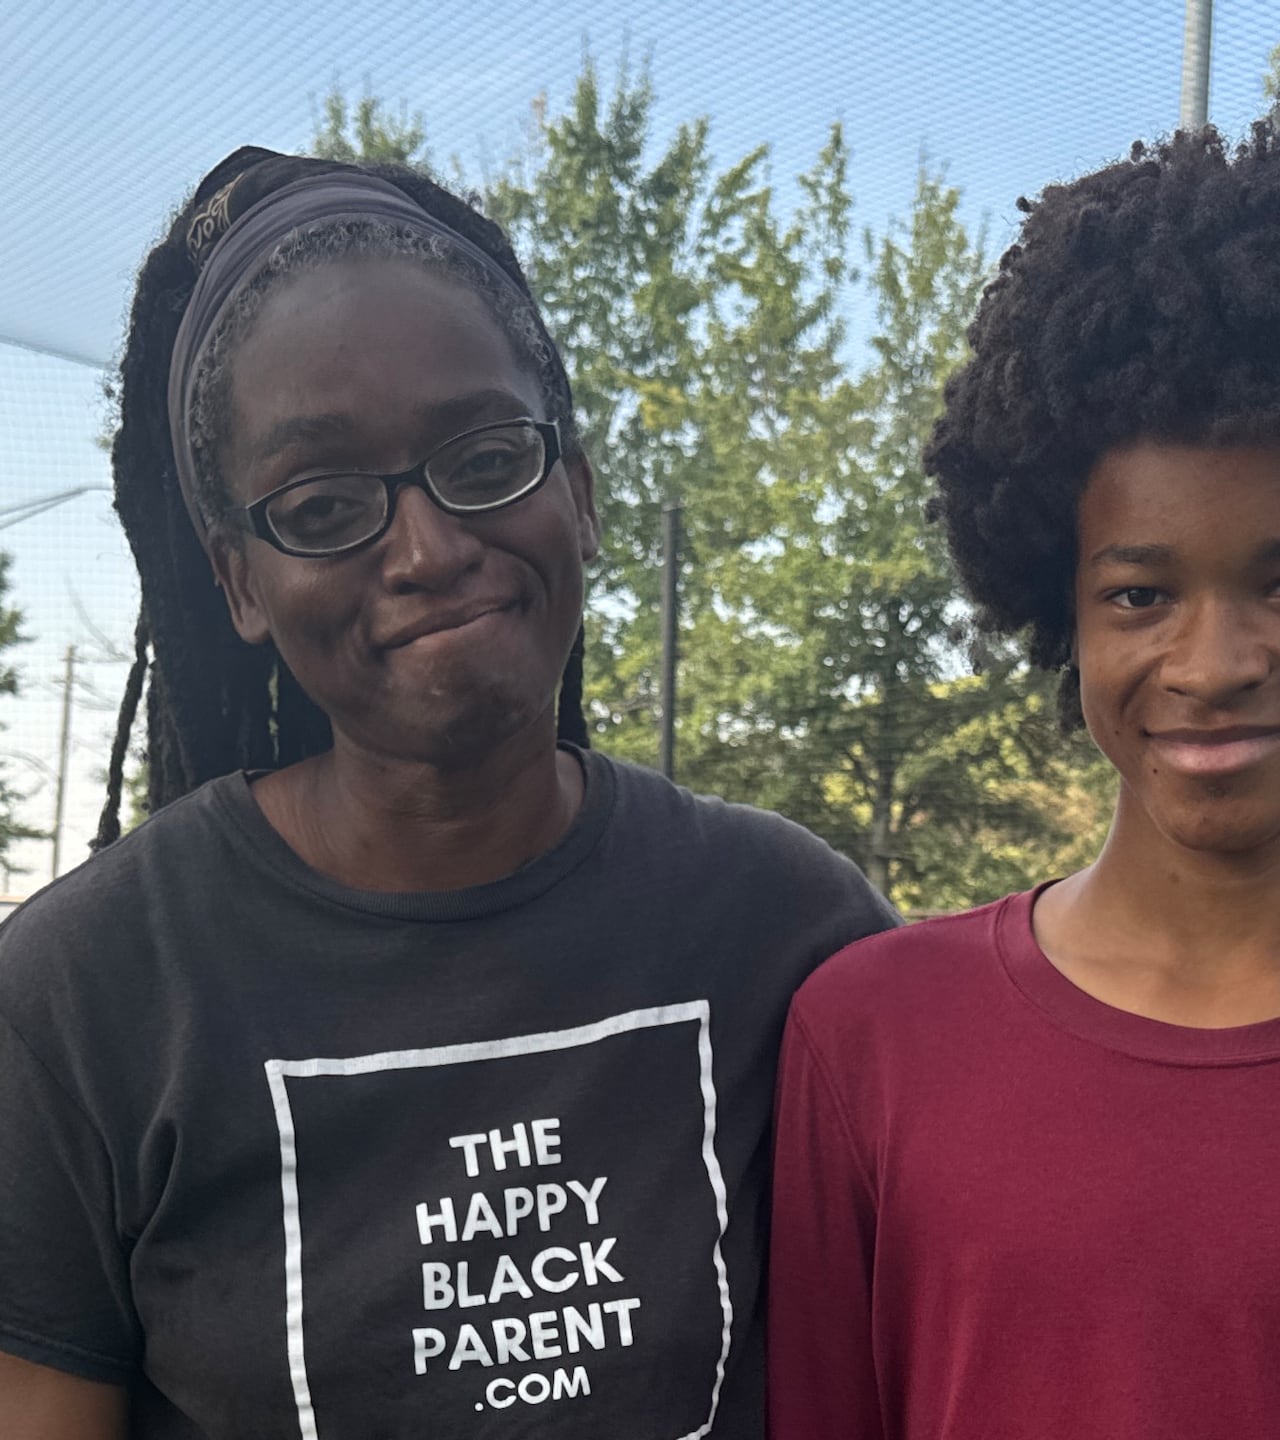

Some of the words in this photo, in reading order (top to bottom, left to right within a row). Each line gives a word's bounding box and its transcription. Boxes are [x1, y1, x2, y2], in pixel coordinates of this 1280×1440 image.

[449, 1118, 561, 1177] THE
[415, 1176, 608, 1245] HAPPY
[422, 1237, 625, 1310] BLACK
[412, 1298, 641, 1375] PARENT
[474, 1366, 591, 1412] .COM
